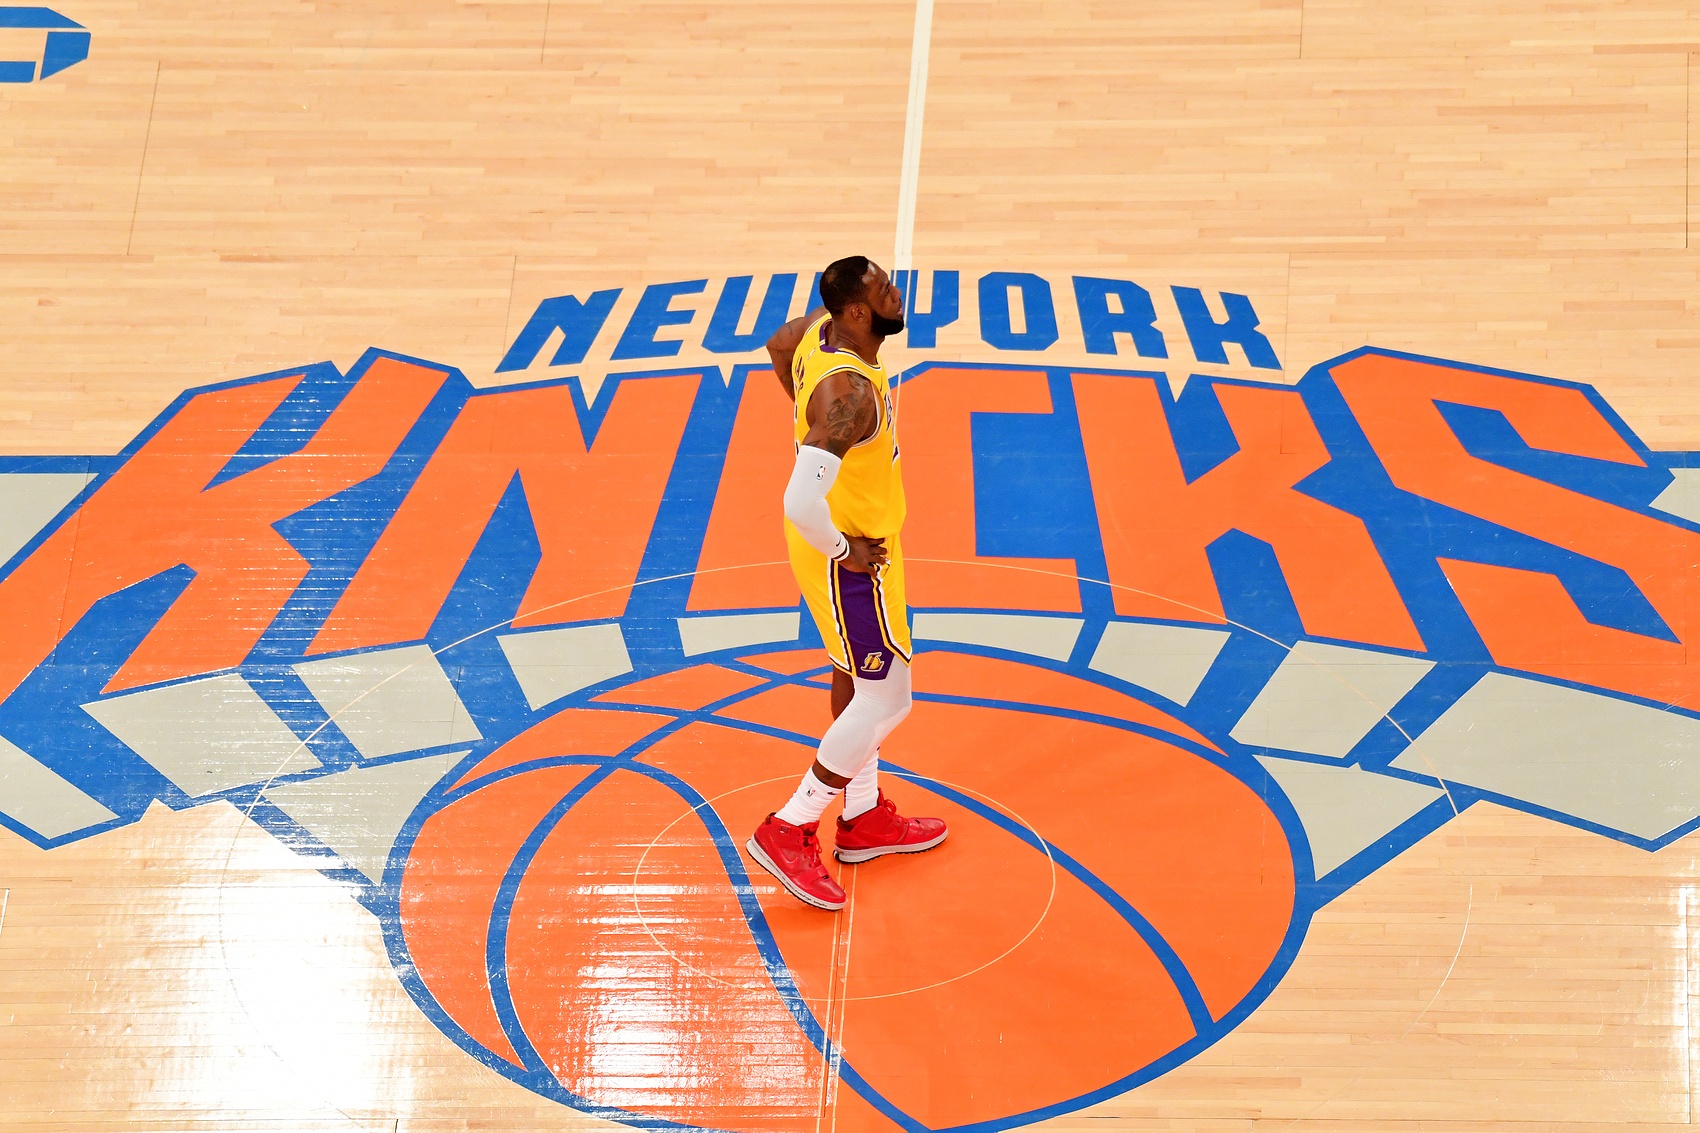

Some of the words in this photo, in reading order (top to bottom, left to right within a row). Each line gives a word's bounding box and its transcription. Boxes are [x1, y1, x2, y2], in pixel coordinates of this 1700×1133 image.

[494, 271, 824, 374] NEW
[890, 269, 1283, 371] YORK
[0, 347, 1700, 712] KNICKS
